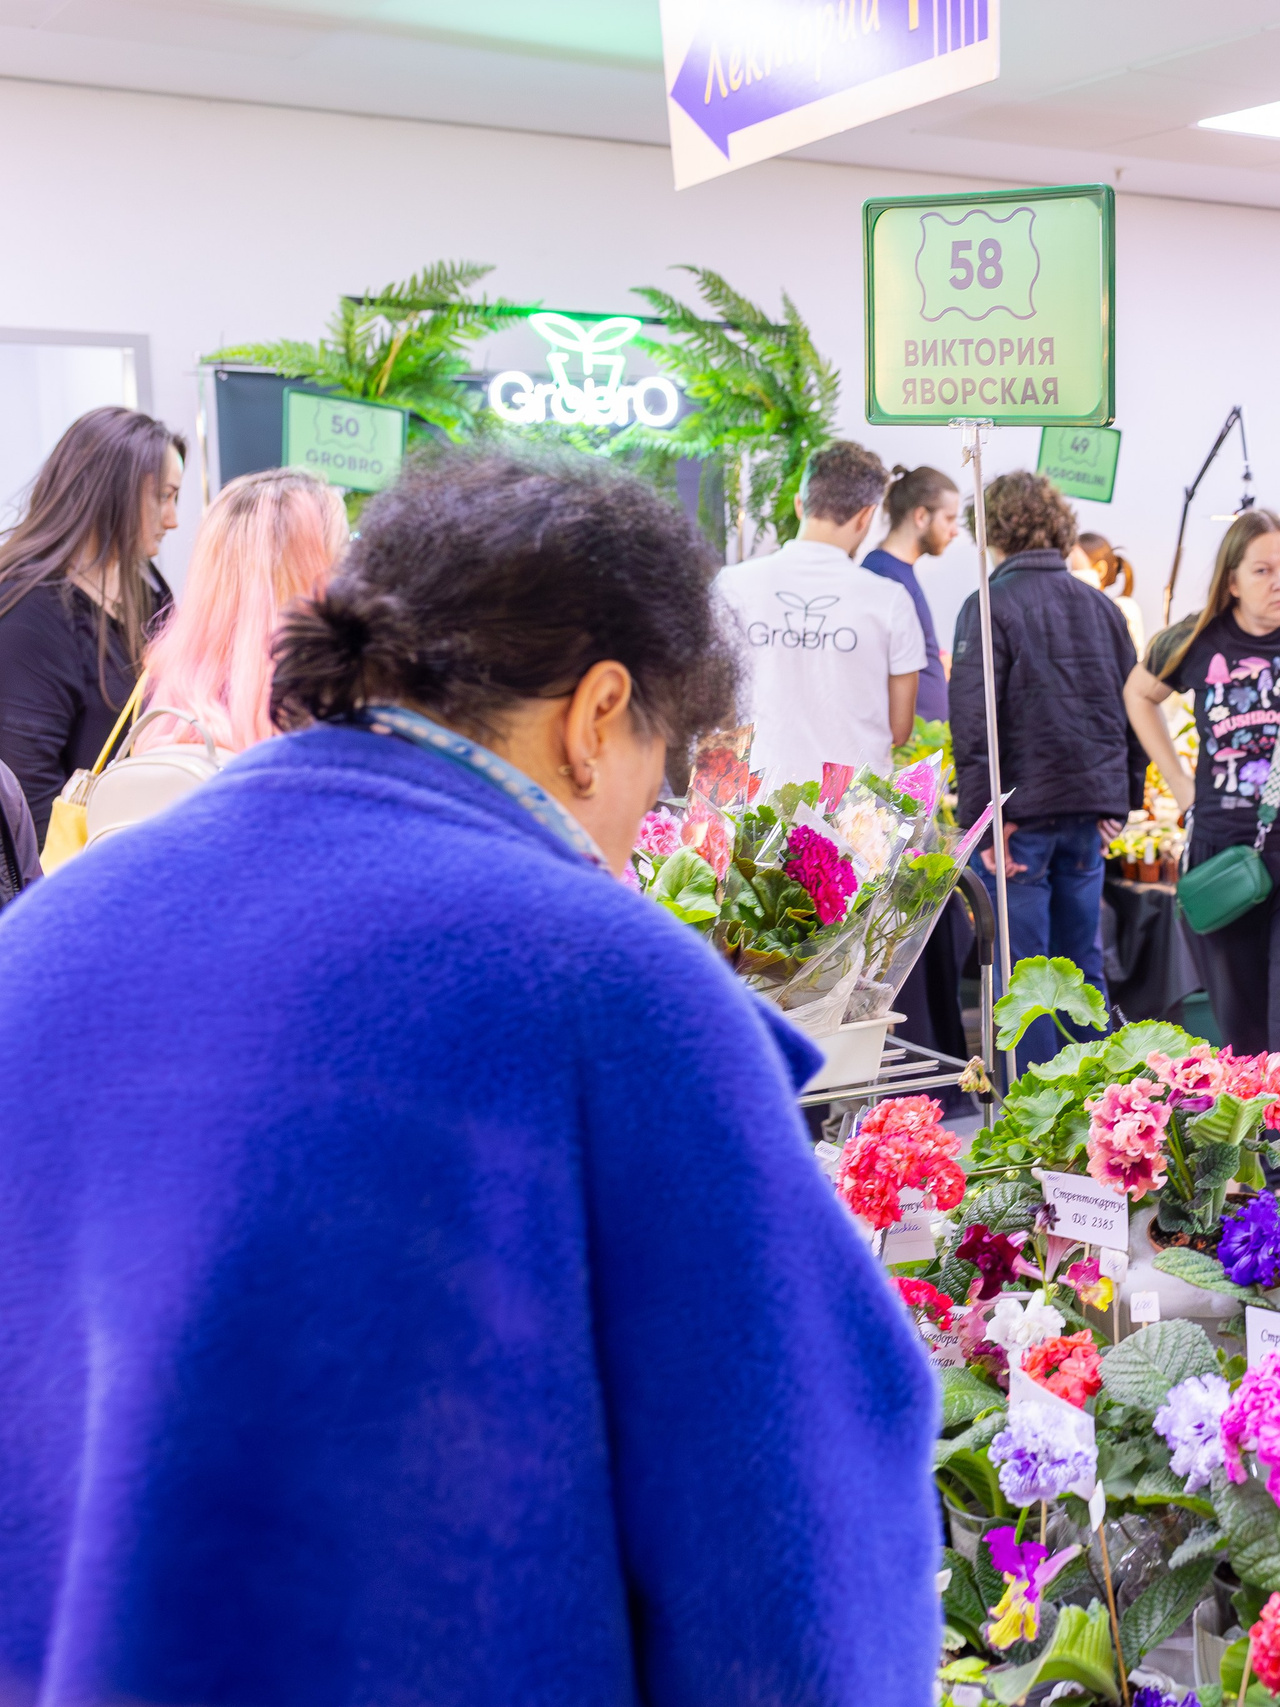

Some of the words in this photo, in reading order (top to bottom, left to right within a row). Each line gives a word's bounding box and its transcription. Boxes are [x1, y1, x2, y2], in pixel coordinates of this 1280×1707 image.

[949, 238, 1004, 290] 58
[904, 337, 1056, 367] ВИКТОРИЯ
[901, 376, 1059, 406] ЯВОРСКАЯ
[331, 414, 360, 437] 50
[1070, 436, 1090, 455] 49
[305, 448, 384, 475] GROBRO
[1052, 1187, 1126, 1213] Стрептокарпус
[1071, 1212, 1087, 1226] DS
[1091, 1216, 1115, 1231] 2385
